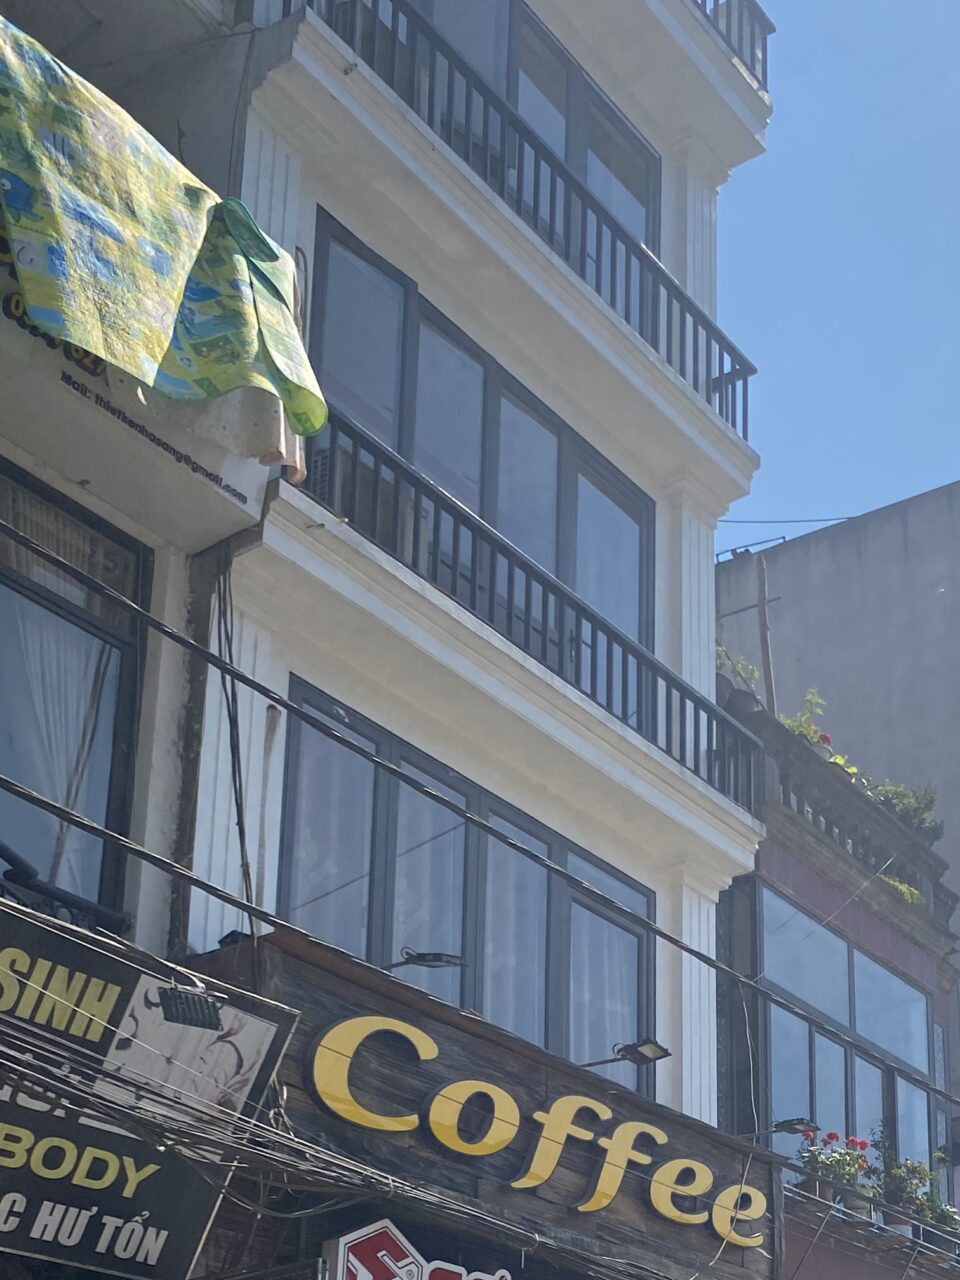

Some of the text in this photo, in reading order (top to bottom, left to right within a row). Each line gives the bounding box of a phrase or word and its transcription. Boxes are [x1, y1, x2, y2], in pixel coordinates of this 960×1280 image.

[0, 947, 122, 1043] SINH
[313, 1016, 767, 1248] Coffee
[30, 1200, 98, 1247] HƯ
[101, 1210, 169, 1266] TỔN
